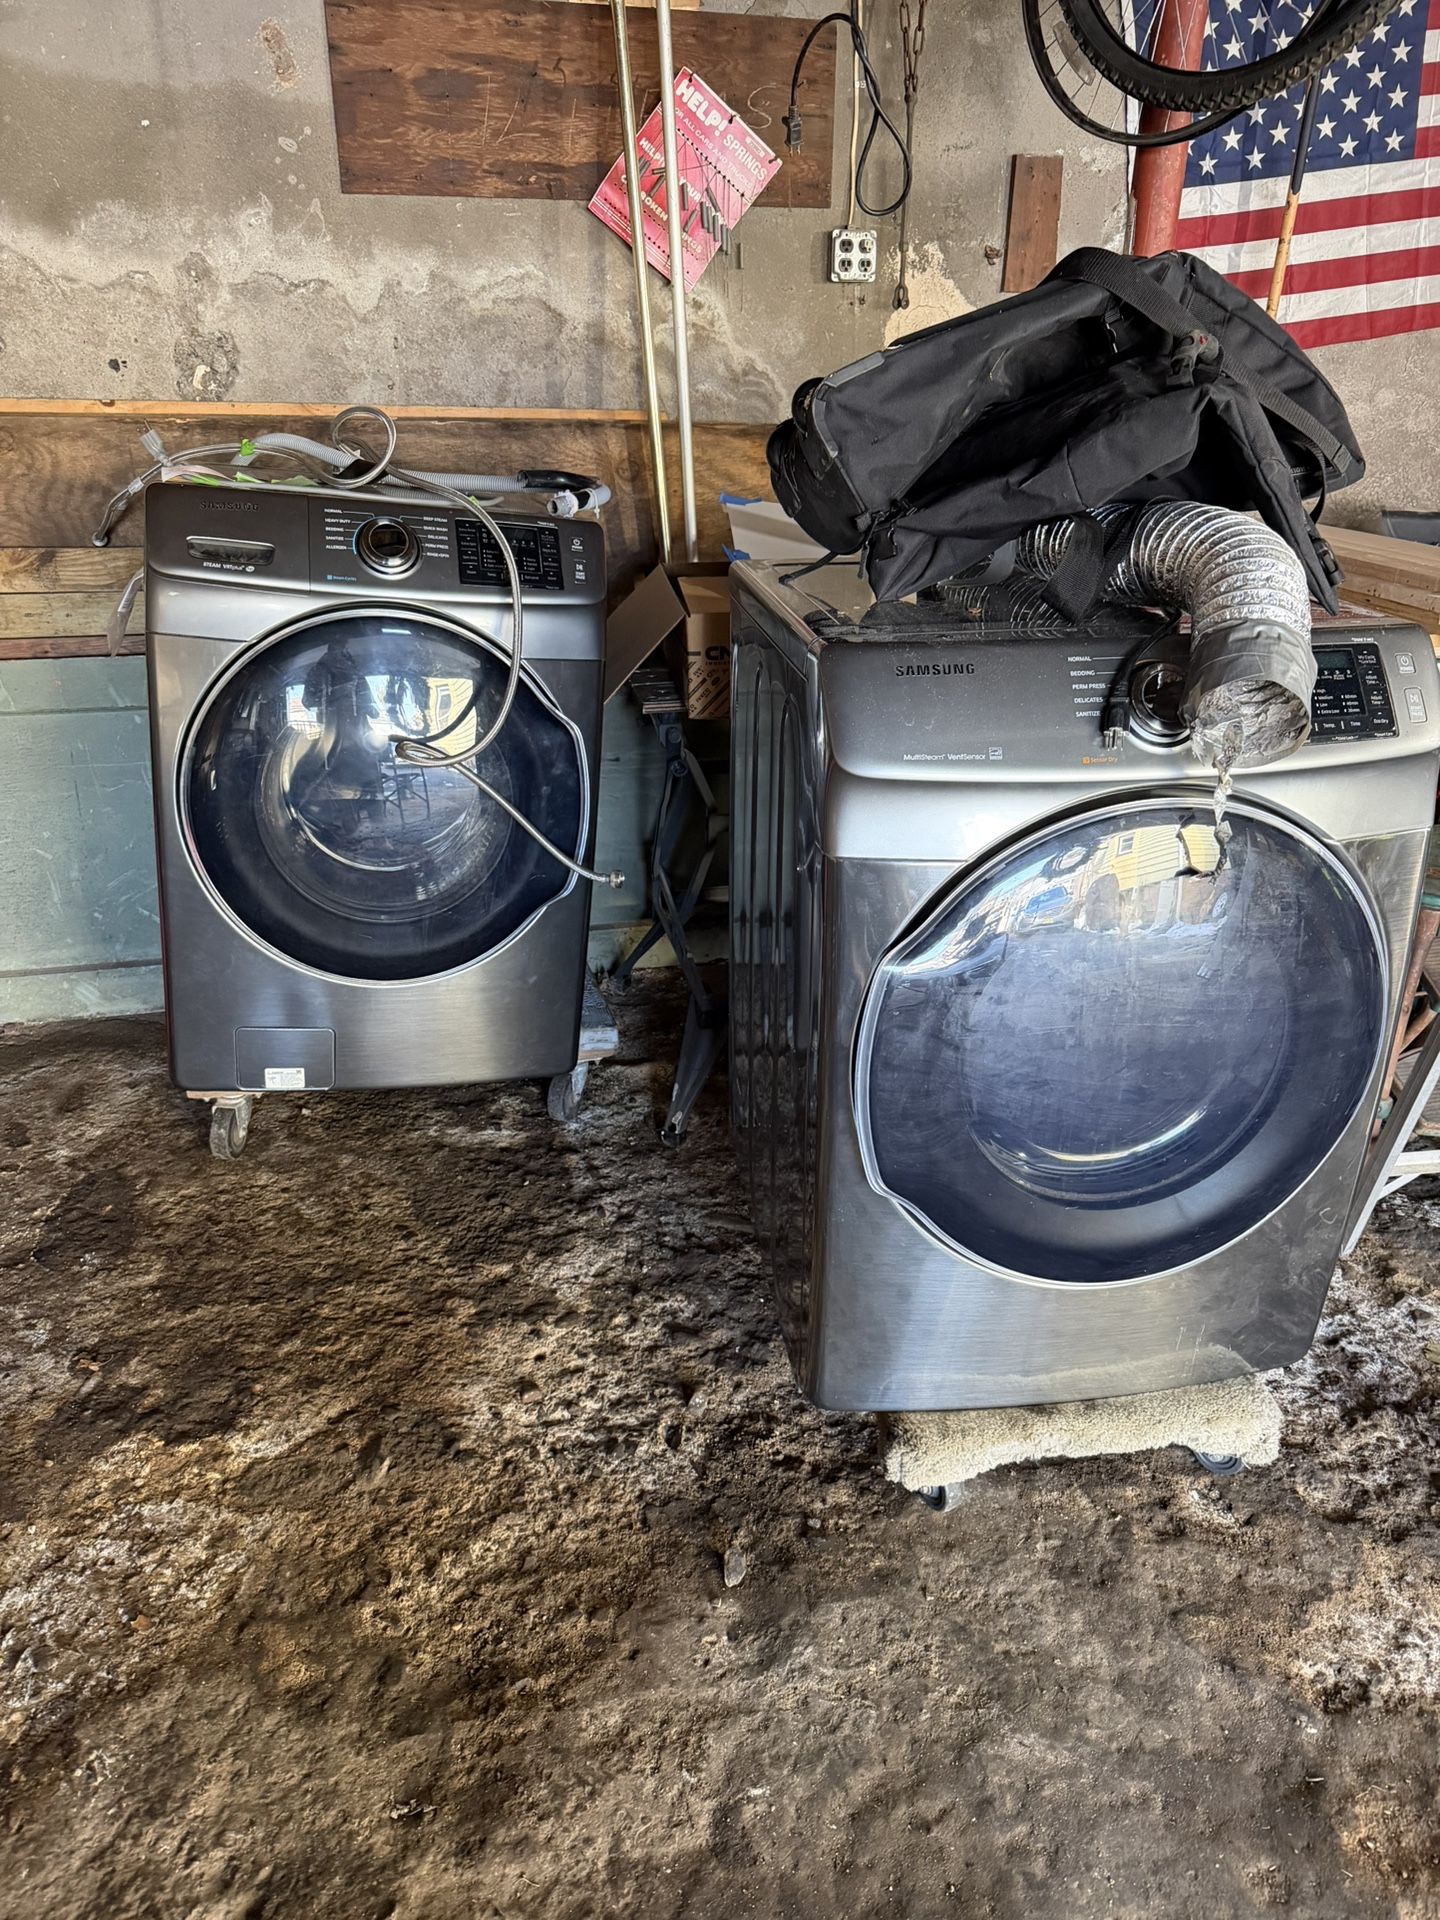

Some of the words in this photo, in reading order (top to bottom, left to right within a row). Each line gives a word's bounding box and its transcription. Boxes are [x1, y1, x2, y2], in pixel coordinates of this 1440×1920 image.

[675, 78, 729, 137] HELP!
[722, 133, 767, 181] SPRINGS
[683, 117, 695, 131] ALL
[695, 129, 714, 150] CARS
[200, 501, 259, 511] SAMSUNG
[895, 663, 975, 677] SAMSUNG
